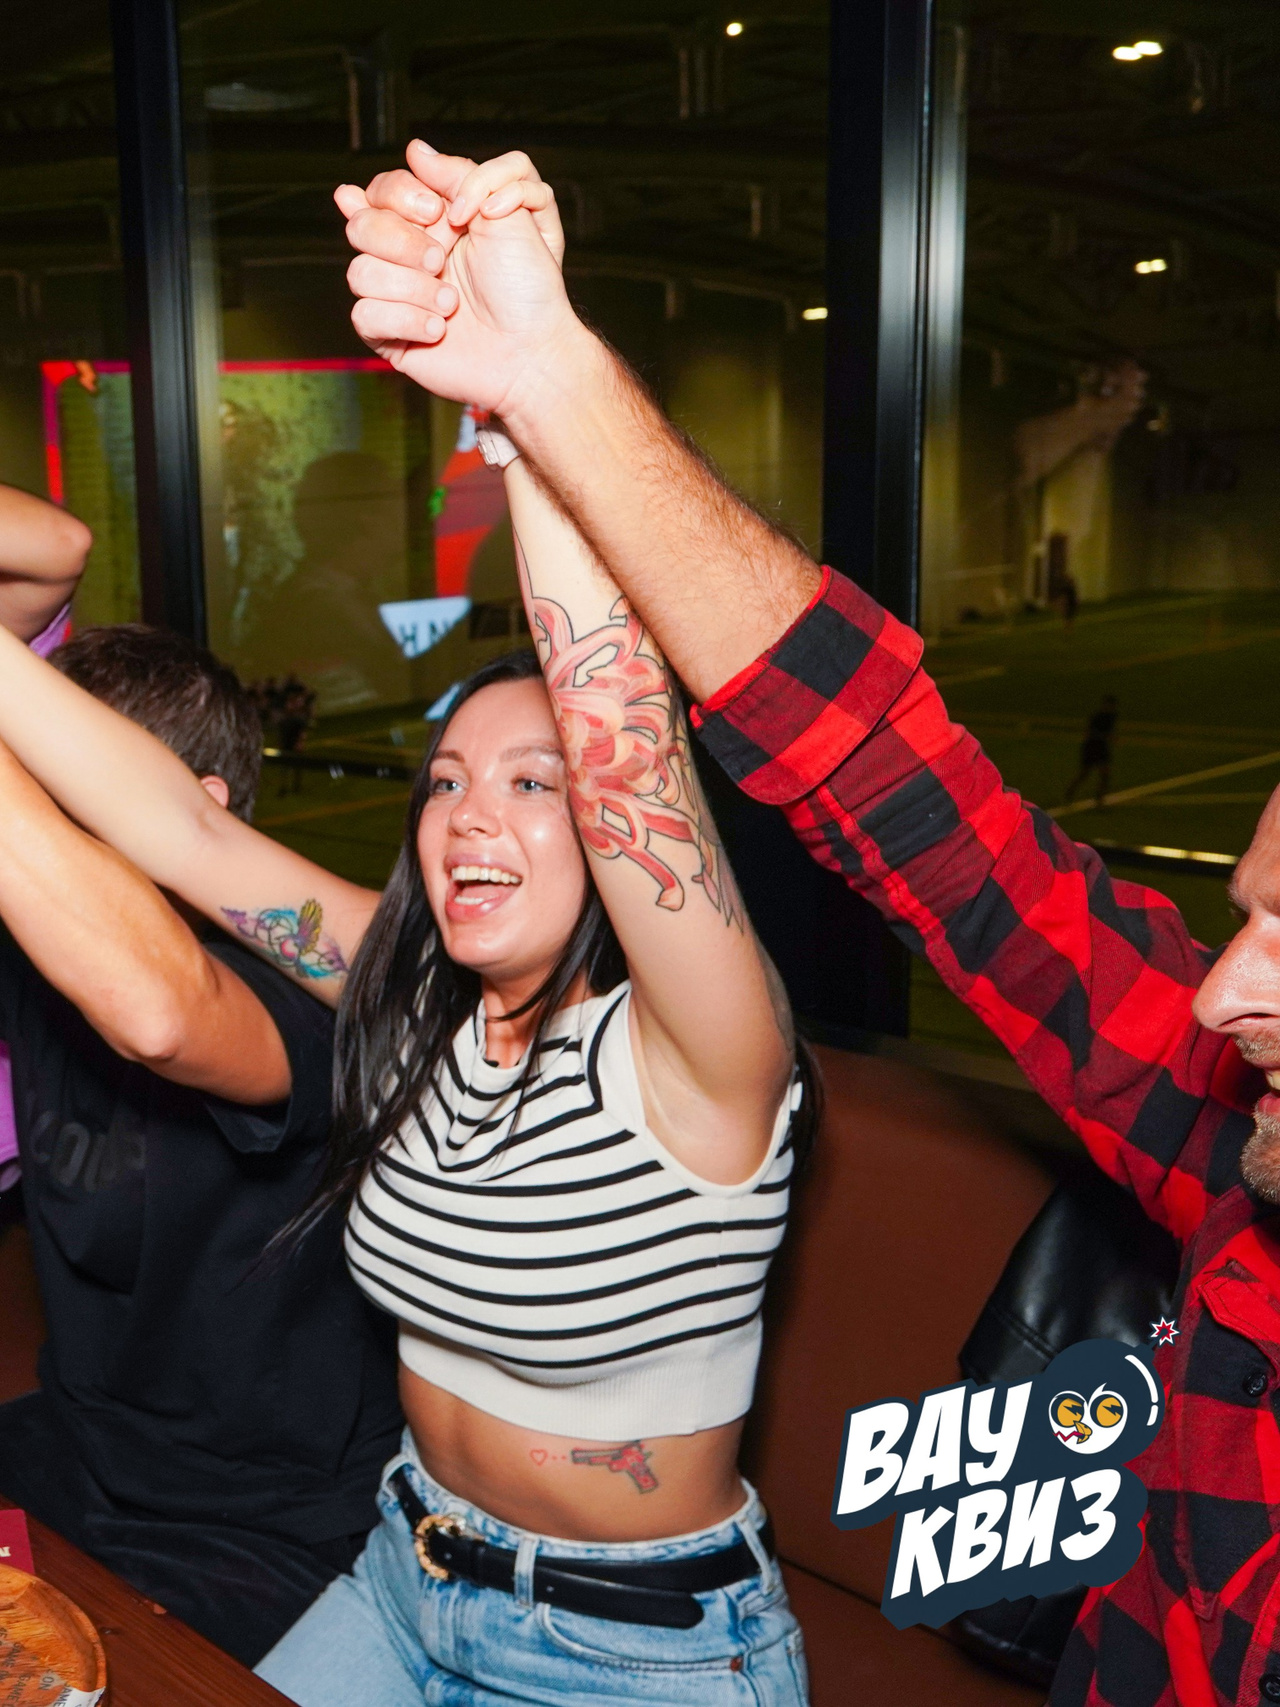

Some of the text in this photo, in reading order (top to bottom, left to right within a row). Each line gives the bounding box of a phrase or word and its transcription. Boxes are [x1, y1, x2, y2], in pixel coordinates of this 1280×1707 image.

[6, 1672, 29, 1704] GAME
[39, 1675, 54, 1692] ON
[53, 1682, 71, 1707] AME
